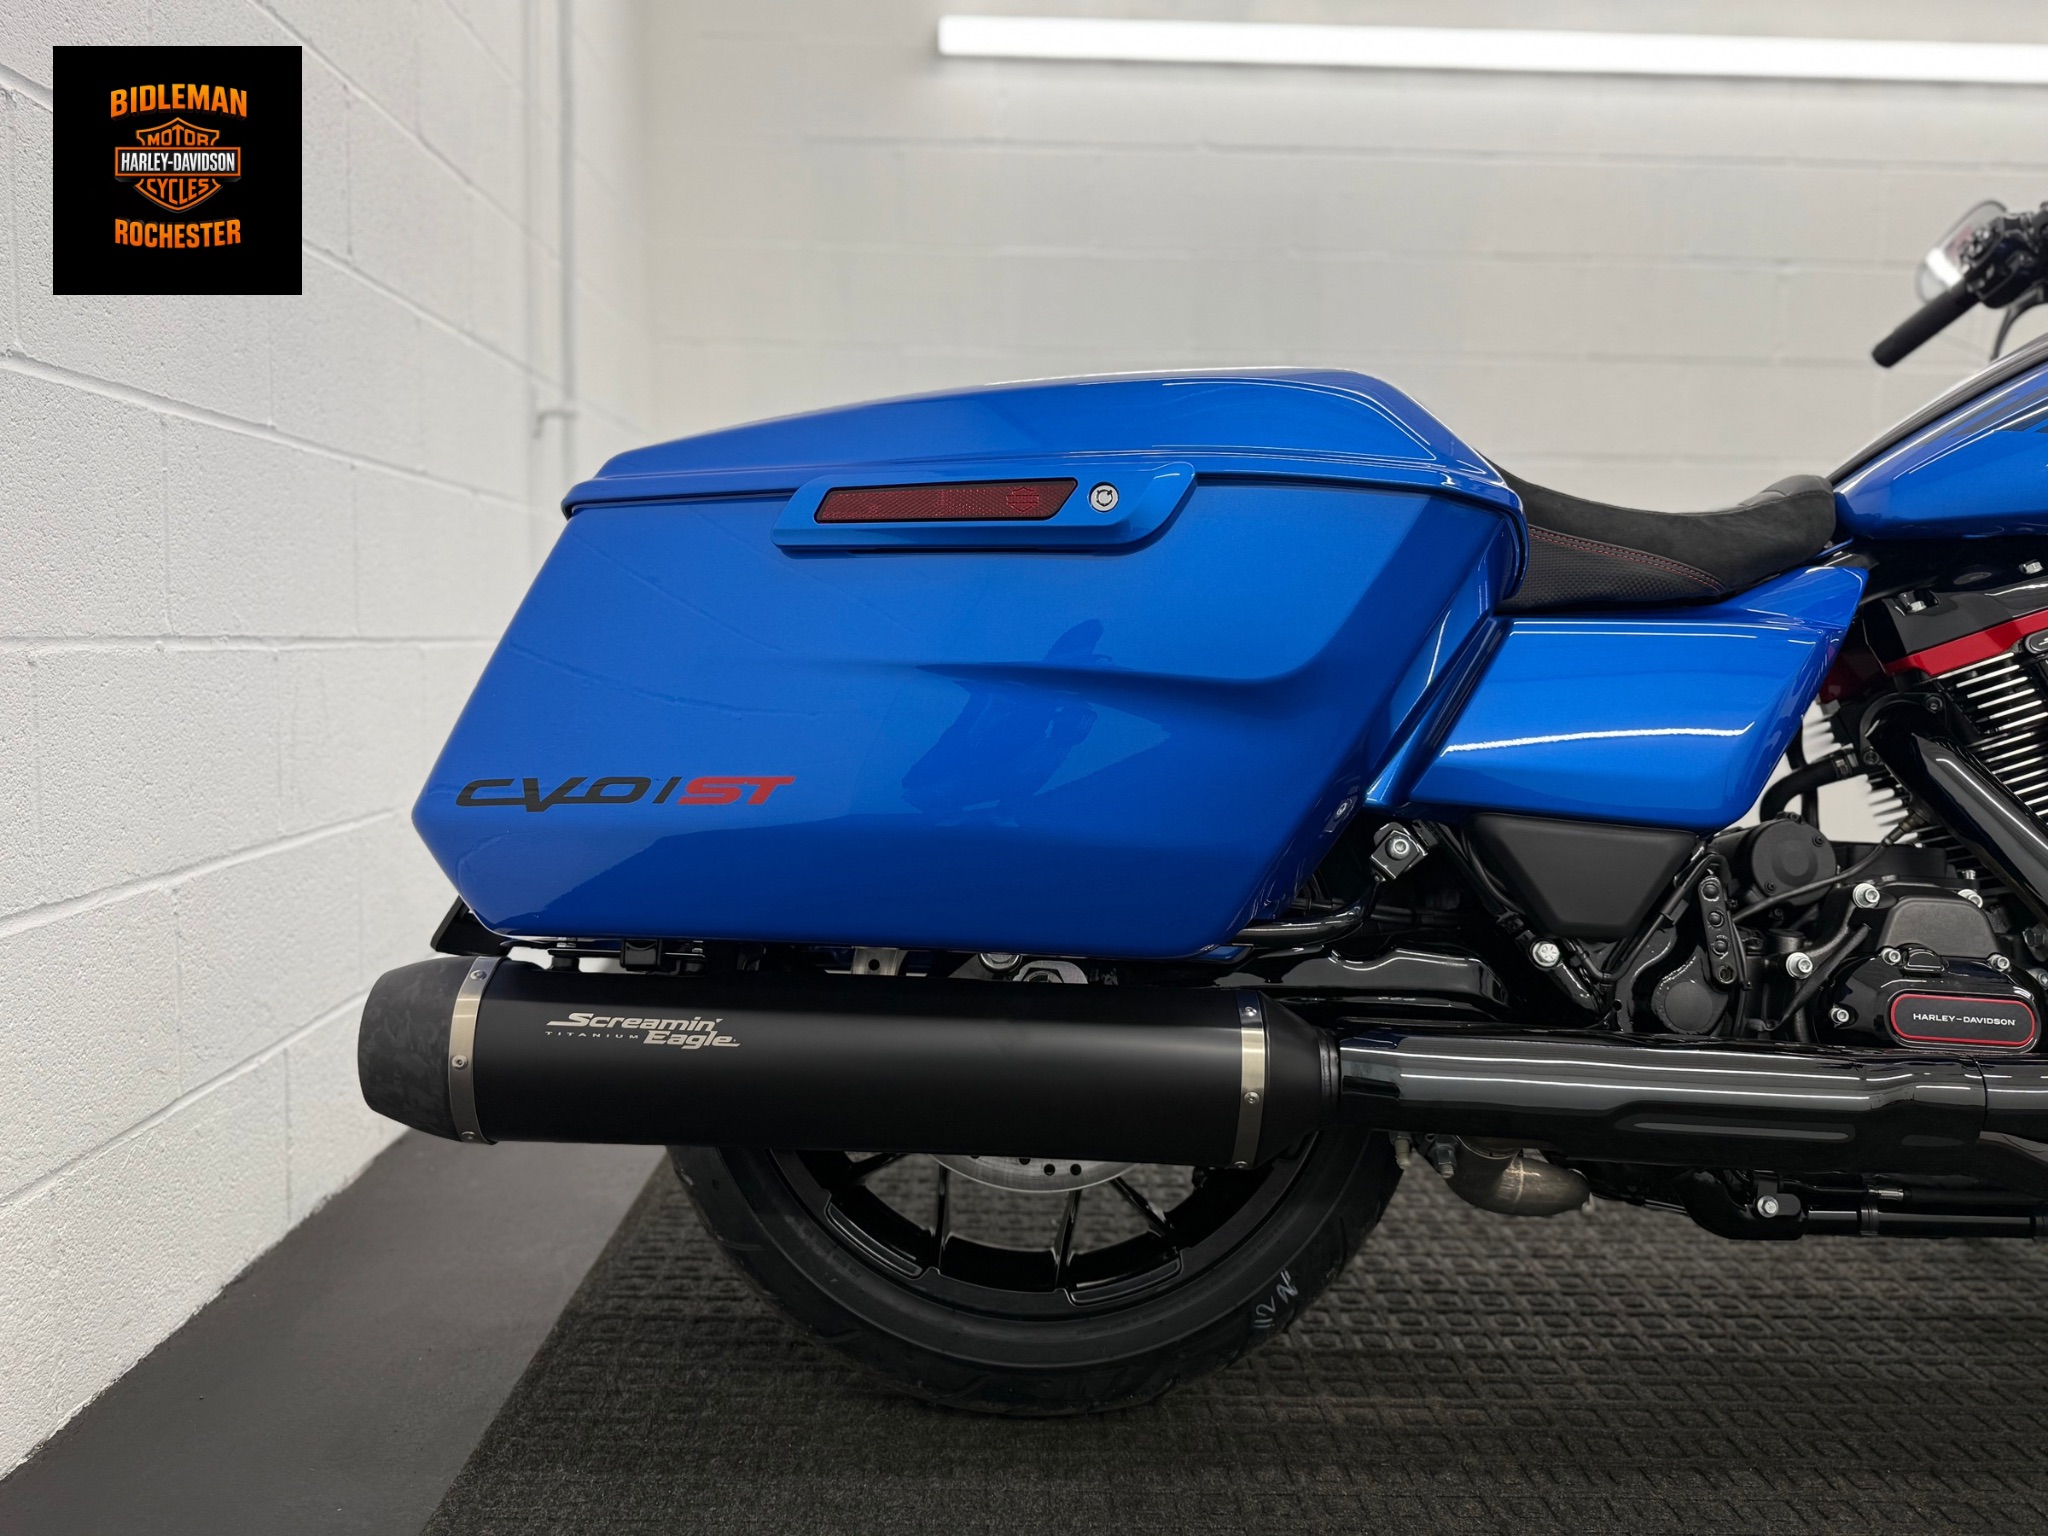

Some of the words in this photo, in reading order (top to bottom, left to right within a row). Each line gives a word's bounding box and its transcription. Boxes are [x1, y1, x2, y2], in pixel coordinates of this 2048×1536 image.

[1912, 1013, 2016, 1026] HARLEY-DAVIDSON
[545, 1031, 639, 1039] TITANIUM
[643, 1030, 740, 1050] Eagle
